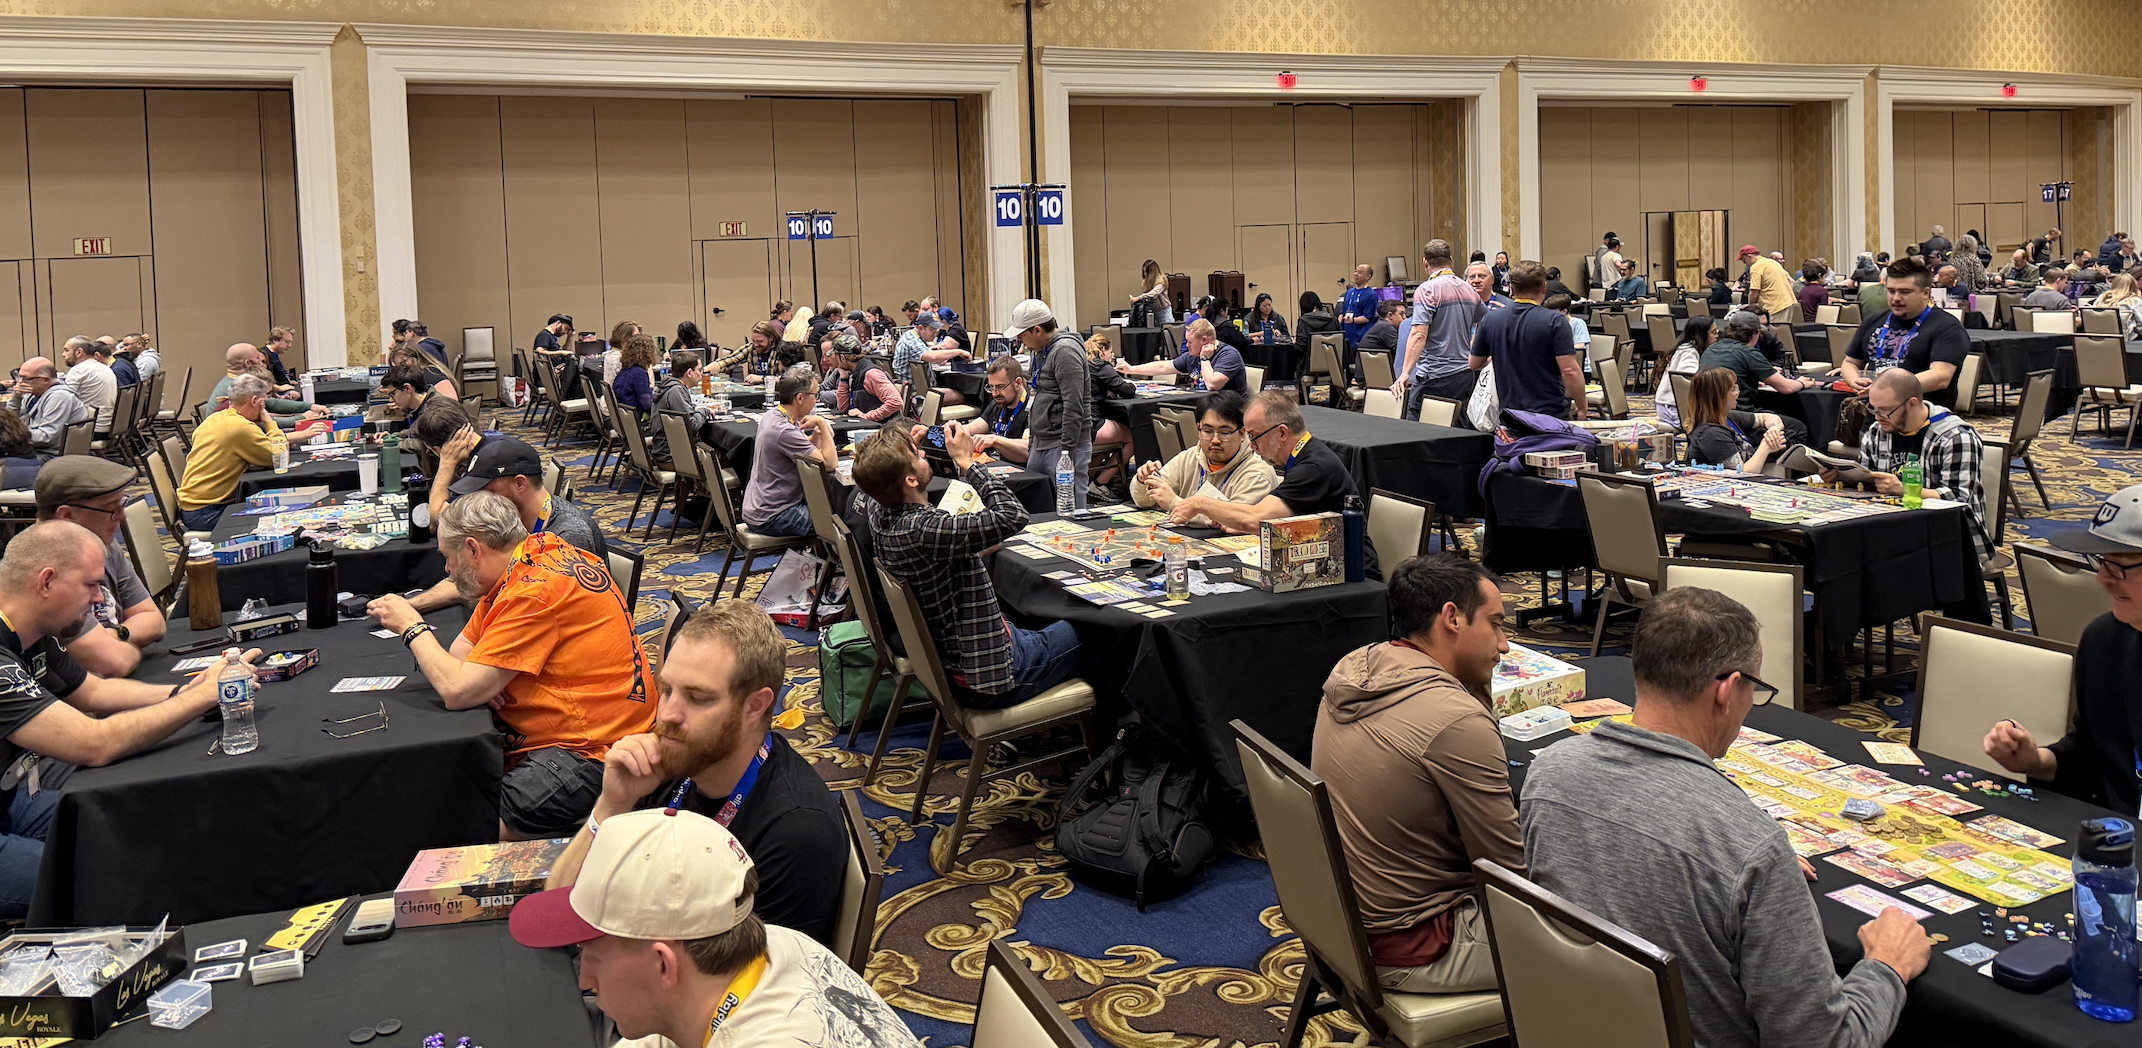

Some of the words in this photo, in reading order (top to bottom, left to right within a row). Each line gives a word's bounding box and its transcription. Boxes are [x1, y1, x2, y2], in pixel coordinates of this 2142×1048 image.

[2043, 189, 2053, 199] 17
[998, 197, 1020, 220] 10
[1039, 196, 1061, 218] 10
[725, 222, 743, 236] EXIT
[789, 220, 805, 235] 10
[816, 220, 832, 235] 10
[82, 238, 105, 254] EXIT
[1289, 542, 1328, 558] ROOT
[133, 960, 162, 996] Vegas
[10, 1001, 50, 1031] Vegas
